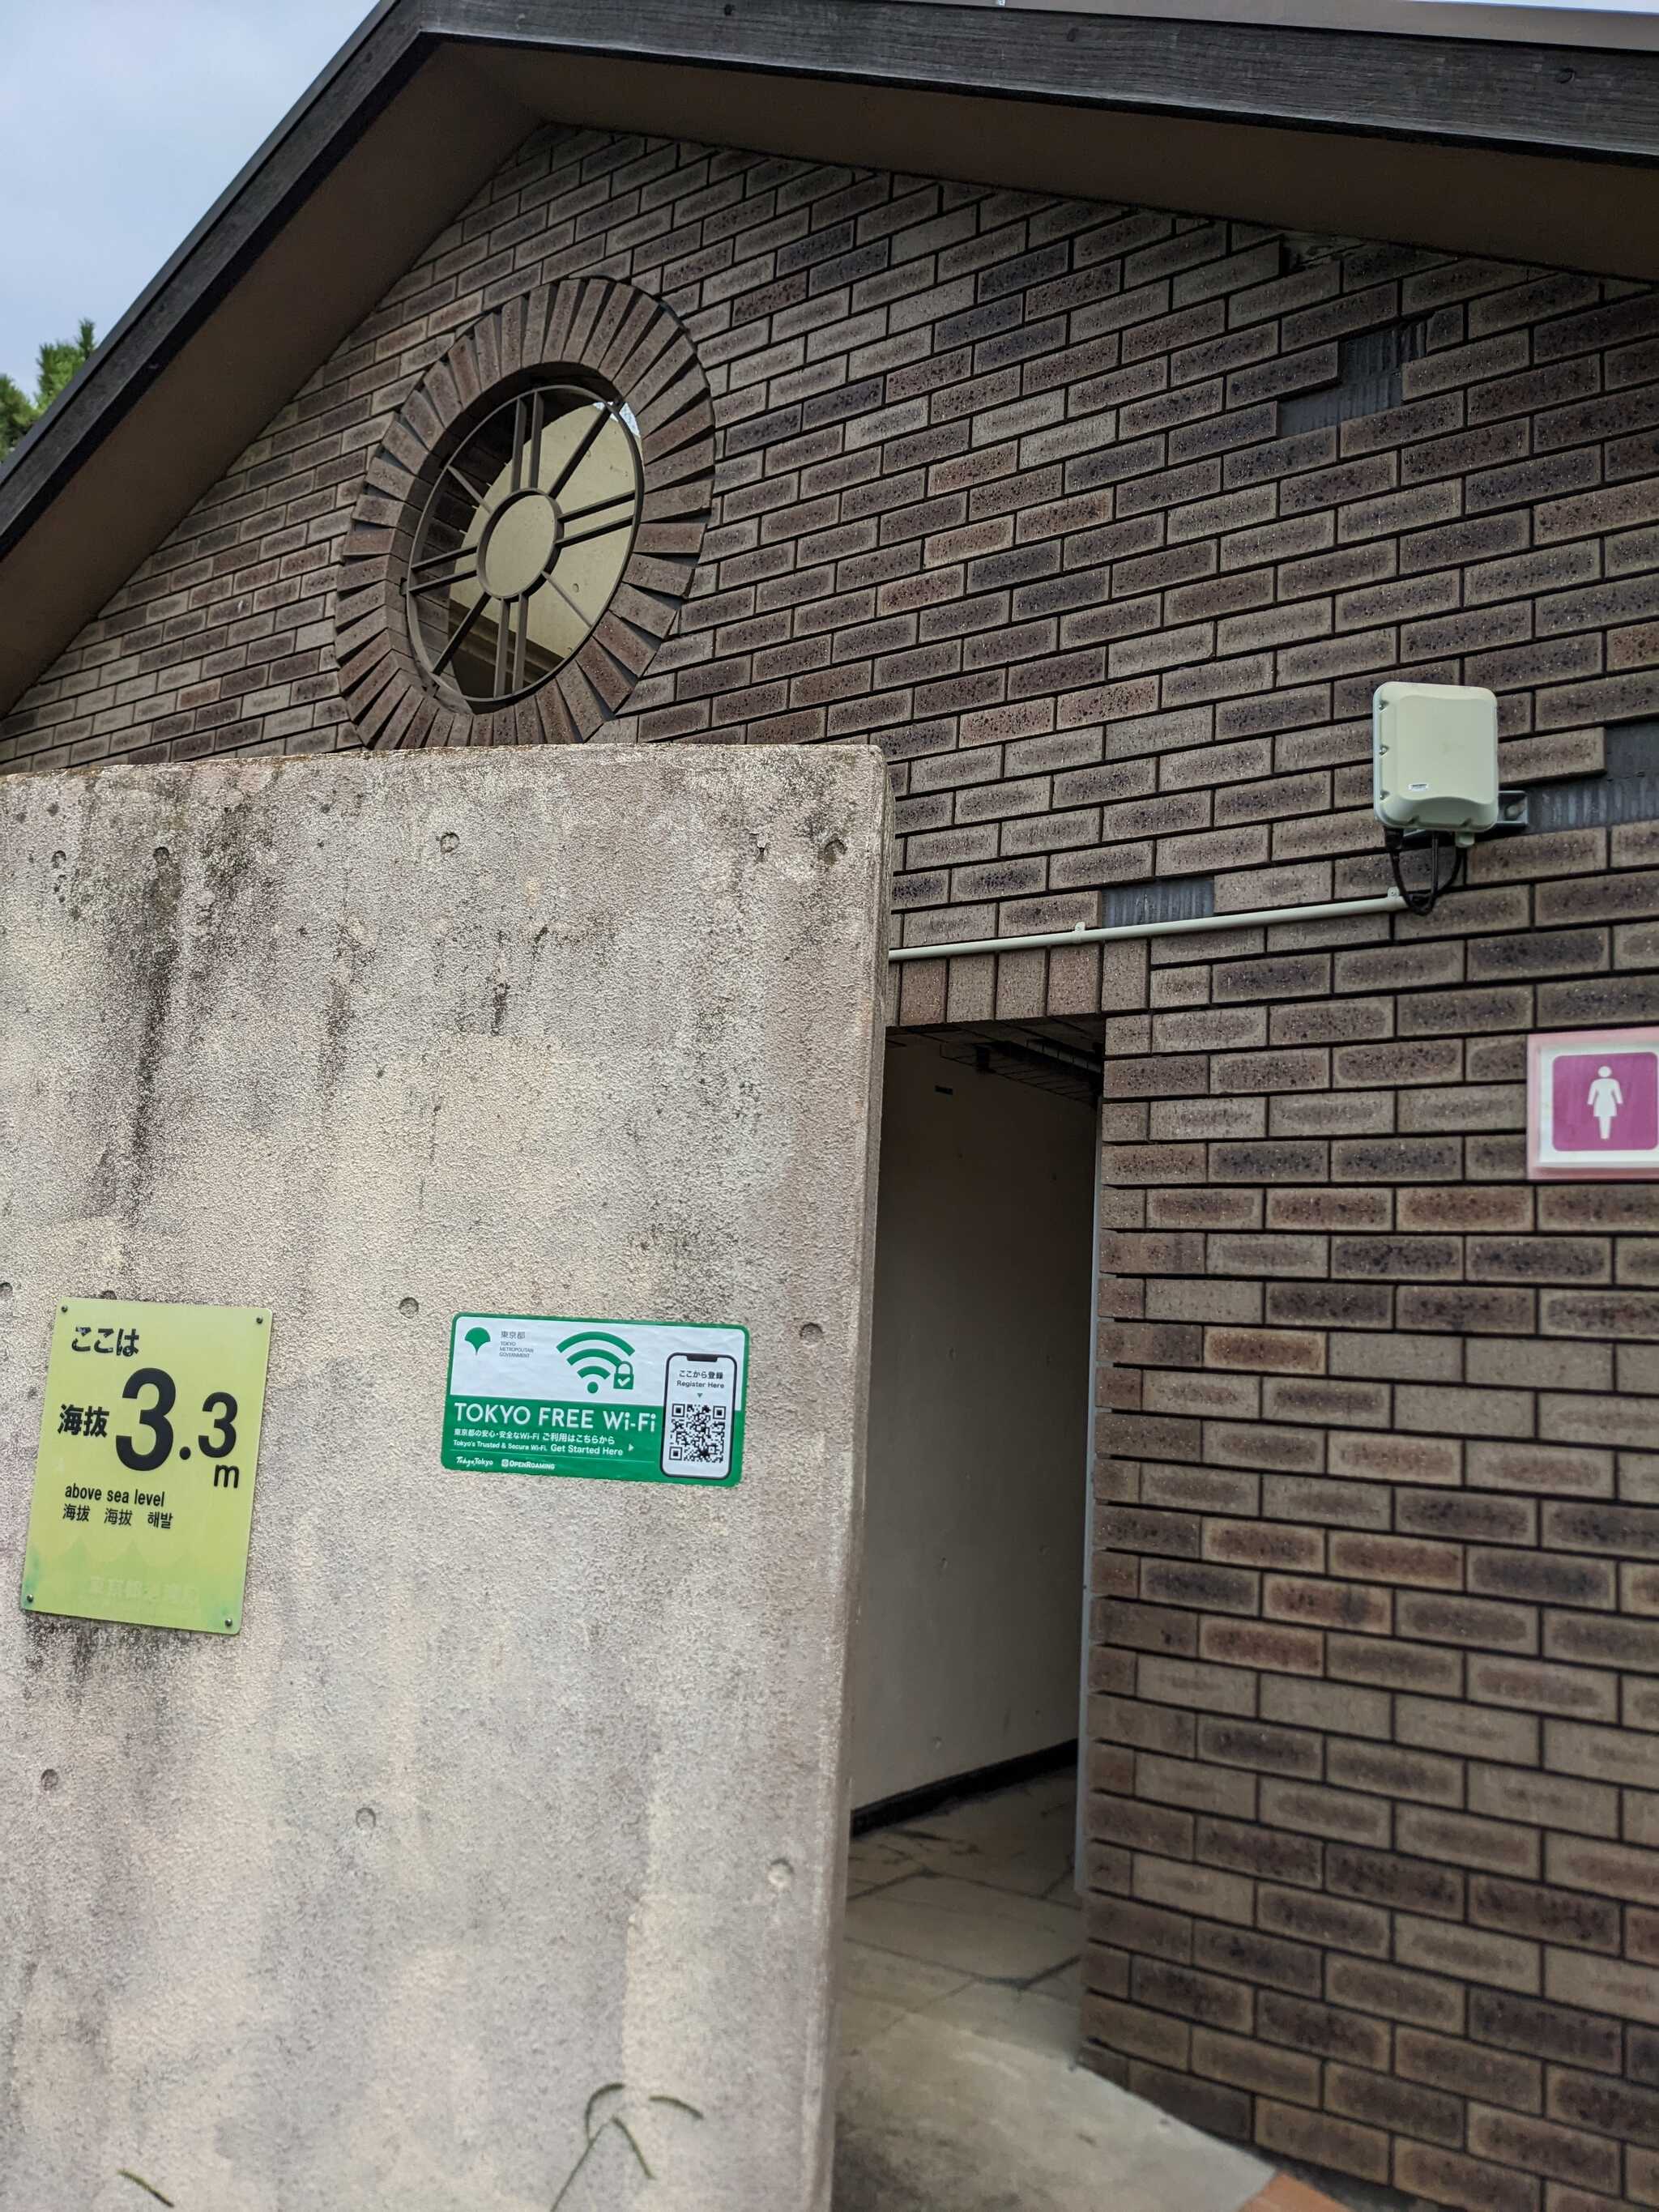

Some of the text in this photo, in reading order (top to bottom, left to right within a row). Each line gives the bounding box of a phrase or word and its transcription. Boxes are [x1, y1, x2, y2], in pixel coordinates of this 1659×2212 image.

[71, 1327, 139, 1357] ここは
[501, 1331, 526, 1340] 東京都
[679, 1370, 723, 1379] ここから登録
[676, 1379, 706, 1388] Register
[454, 1402, 656, 1432] TOKYO FREE Wi-Fi
[58, 1367, 240, 1488] 海抜 3.3 m
[453, 1439, 476, 1449] Tokyo's
[476, 1440, 500, 1449] Trusted
[508, 1443, 529, 1451] Secure
[550, 1444, 565, 1453] Get
[568, 1445, 600, 1455] Started
[602, 1447, 623, 1455] Here
[542, 1432, 615, 1445] ご利用はこちらから
[65, 1483, 165, 1507] above sea level
[147, 1511, 173, 1529] 해발
